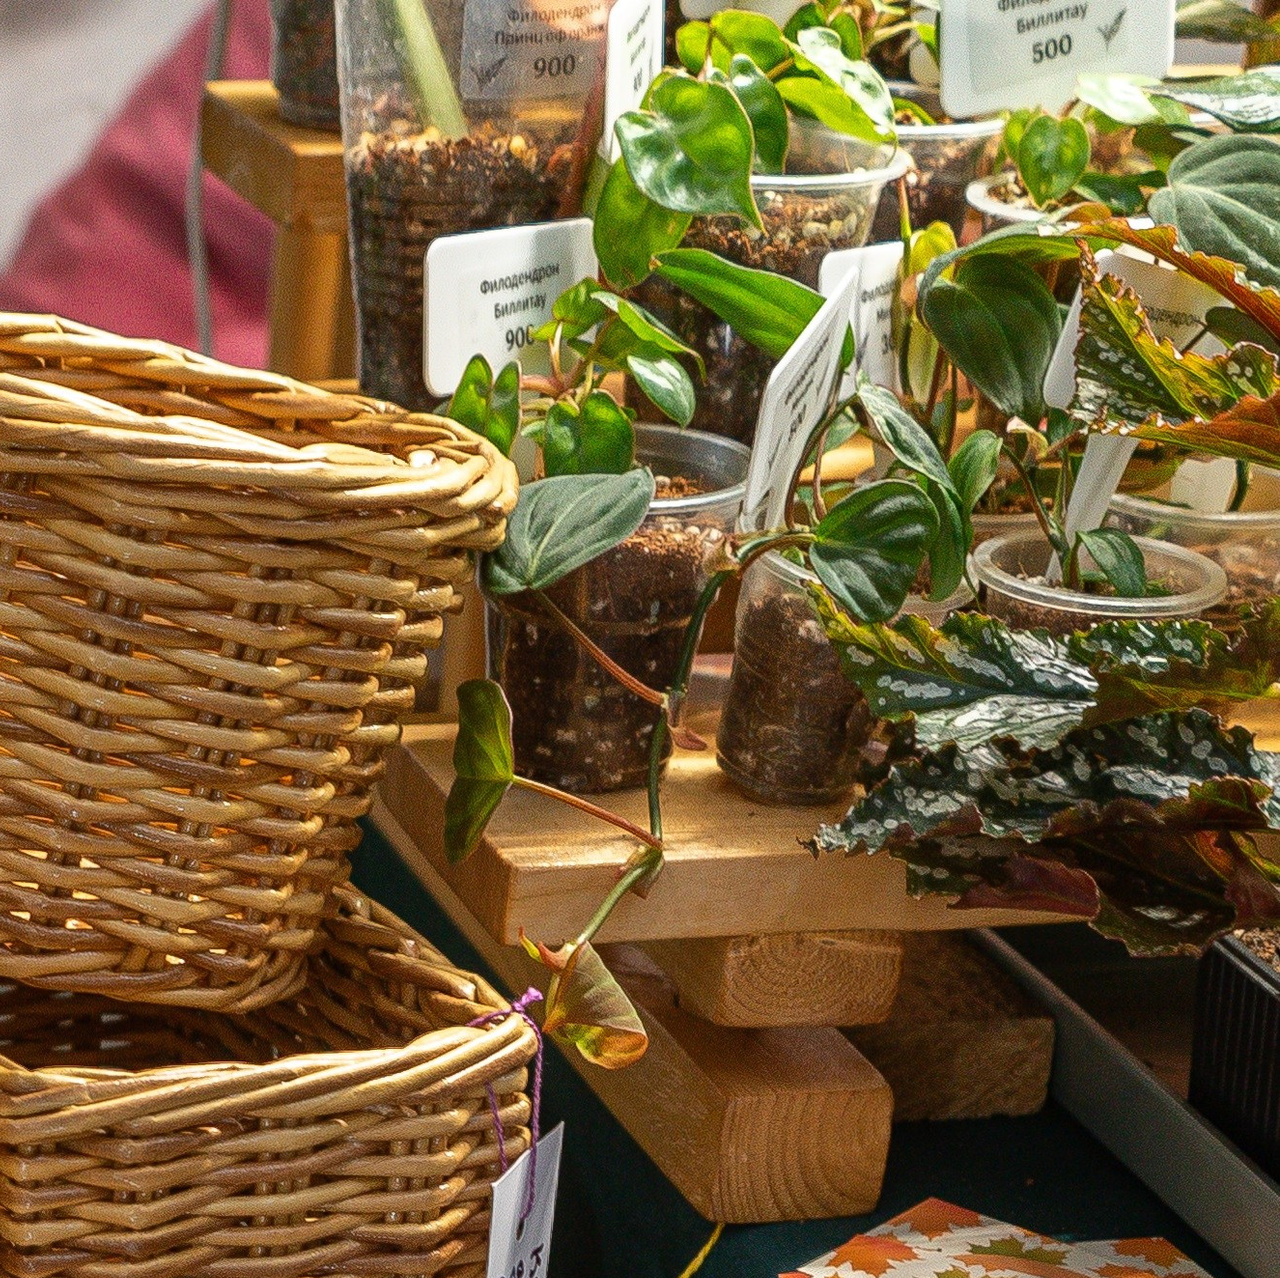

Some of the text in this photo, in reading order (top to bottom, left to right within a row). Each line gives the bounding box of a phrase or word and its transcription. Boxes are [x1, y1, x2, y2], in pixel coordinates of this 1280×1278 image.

[1016, 4, 1088, 34] Биллитау
[1031, 34, 1073, 64] 500
[533, 53, 576, 78] 900
[480, 264, 561, 294] Филодендрон
[494, 293, 547, 319] Биллитау
